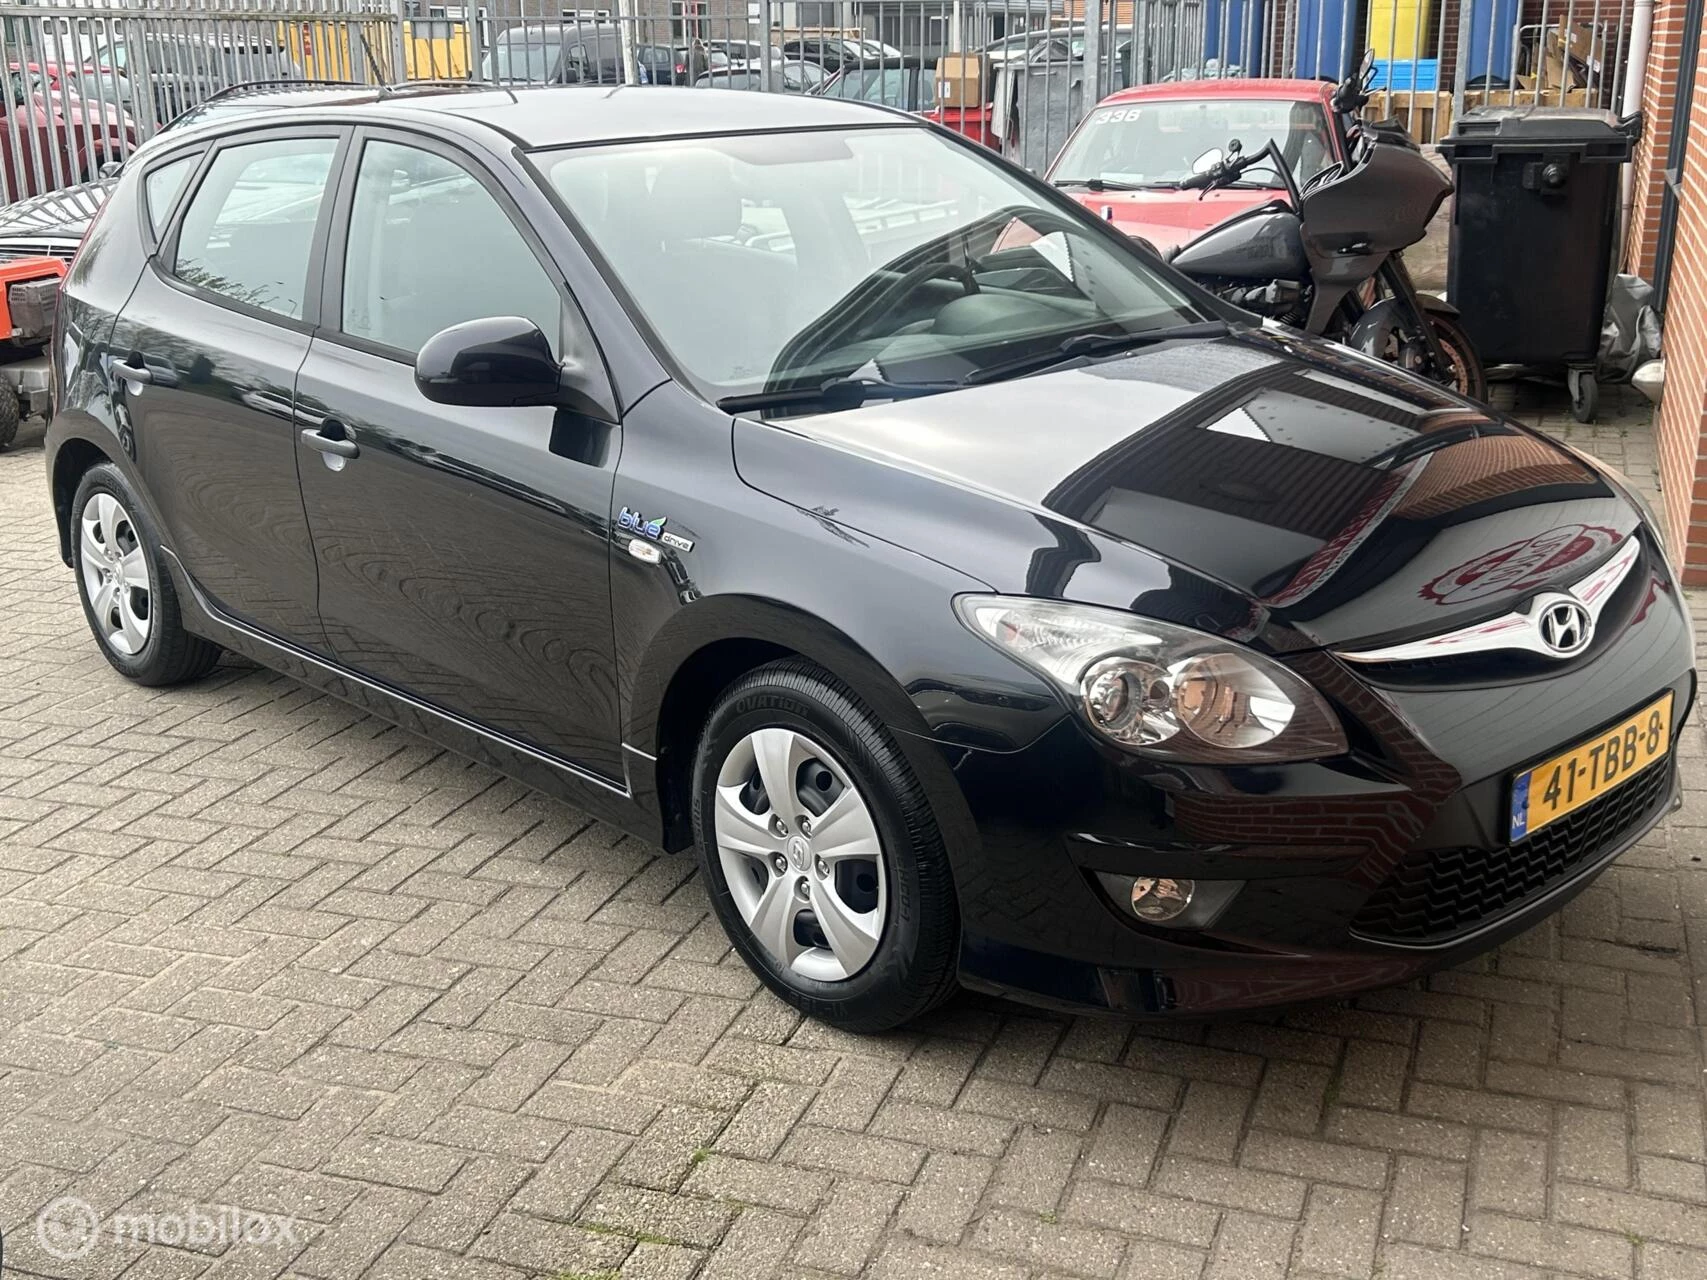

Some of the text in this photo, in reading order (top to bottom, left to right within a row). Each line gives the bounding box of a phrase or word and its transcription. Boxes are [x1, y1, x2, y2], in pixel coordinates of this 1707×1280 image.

[1095, 109, 1142, 125] 338
[617, 506, 660, 540] blue
[662, 534, 691, 550] drive
[1542, 709, 1660, 811] 41-TBB-8
[1511, 815, 1526, 830] NL
